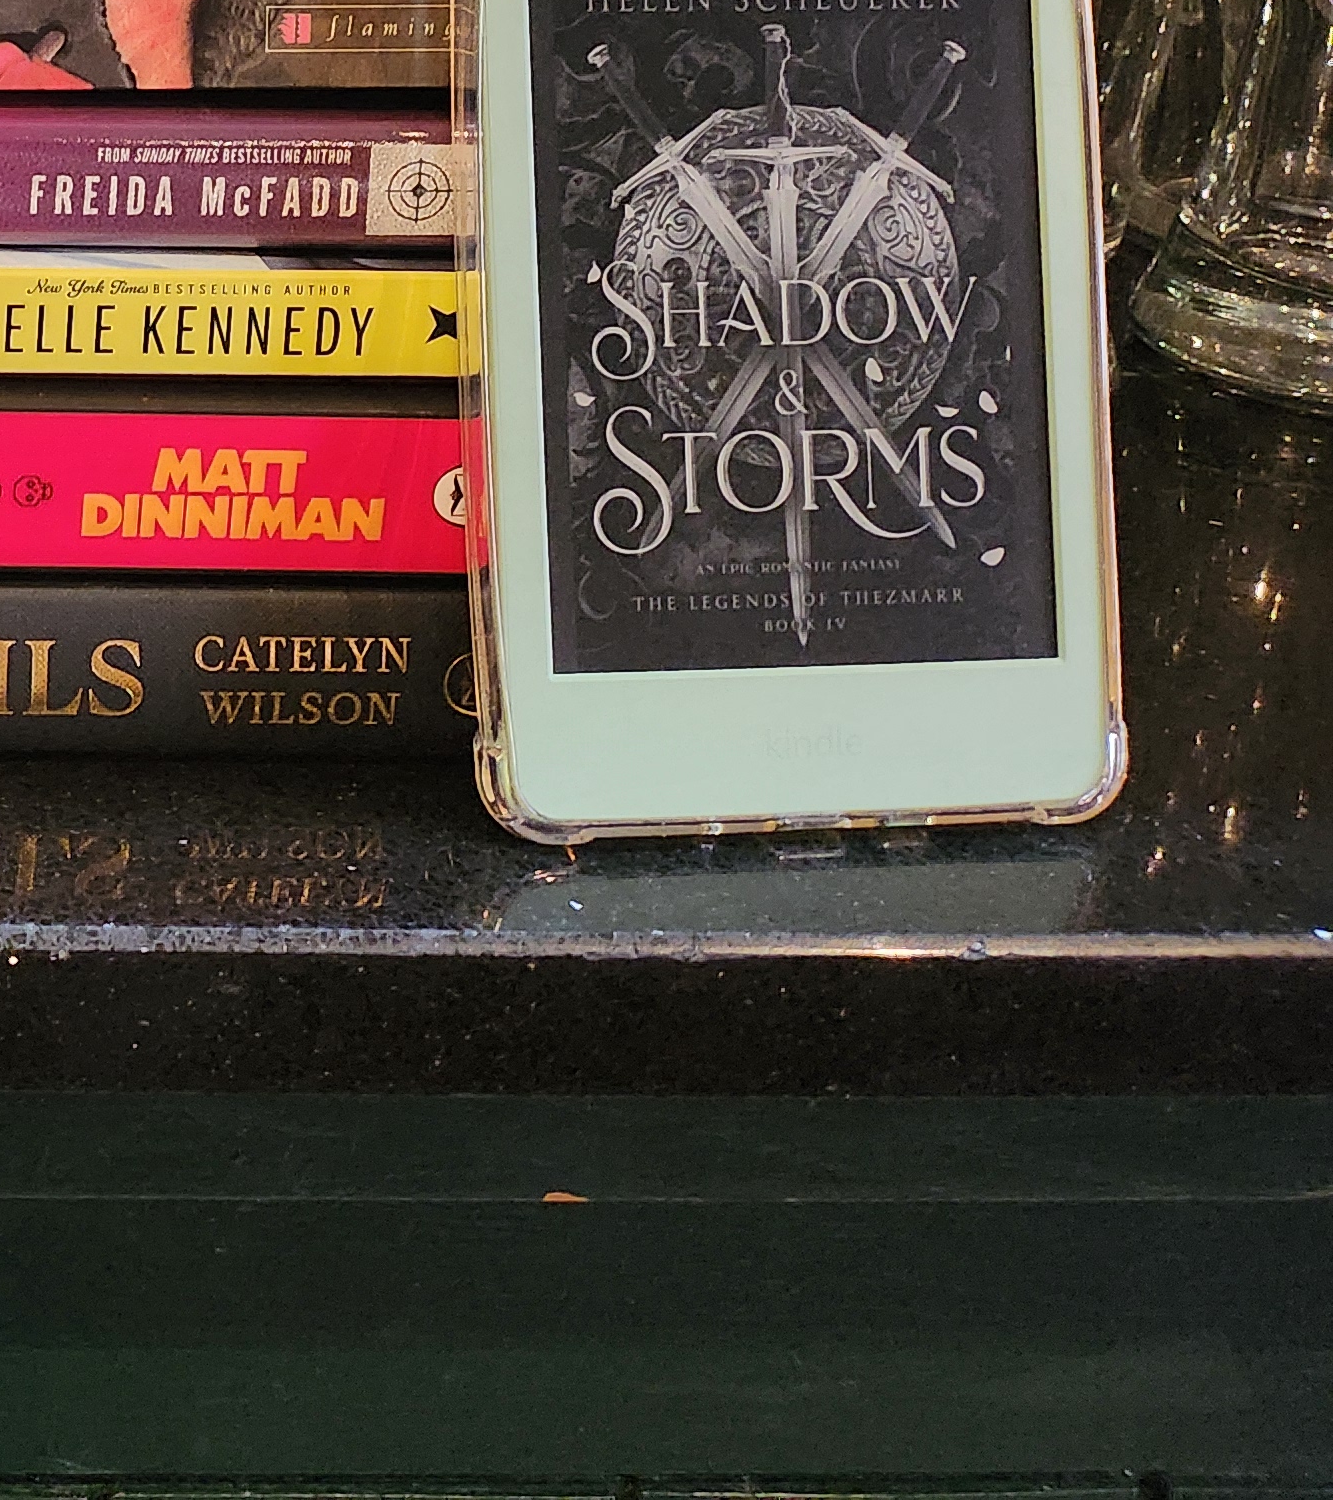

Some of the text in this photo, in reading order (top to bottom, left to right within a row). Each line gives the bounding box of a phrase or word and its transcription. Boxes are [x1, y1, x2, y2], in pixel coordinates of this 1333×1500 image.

[98, 147, 351, 165] FROM SUNDAY TIMES BESTSELLING AUTHOR
[29, 174, 359, 218] FREIDA McFADD
[26, 278, 352, 298] New York Times BESTSELLING AUTHOR
[4, 304, 375, 357] ELLE KENNEDY
[588, 261, 977, 380] SHADOW
[774, 369, 808, 416] &
[151, 447, 307, 494] MATT
[592, 405, 987, 555] STORMS
[81, 494, 385, 541] DINNIMAN
[633, 587, 965, 612] THE LEGENDS OF THEZMARR
[764, 617, 847, 632] BOOK IV
[194, 635, 412, 674] CATELYN
[199, 689, 400, 726] WILSON
